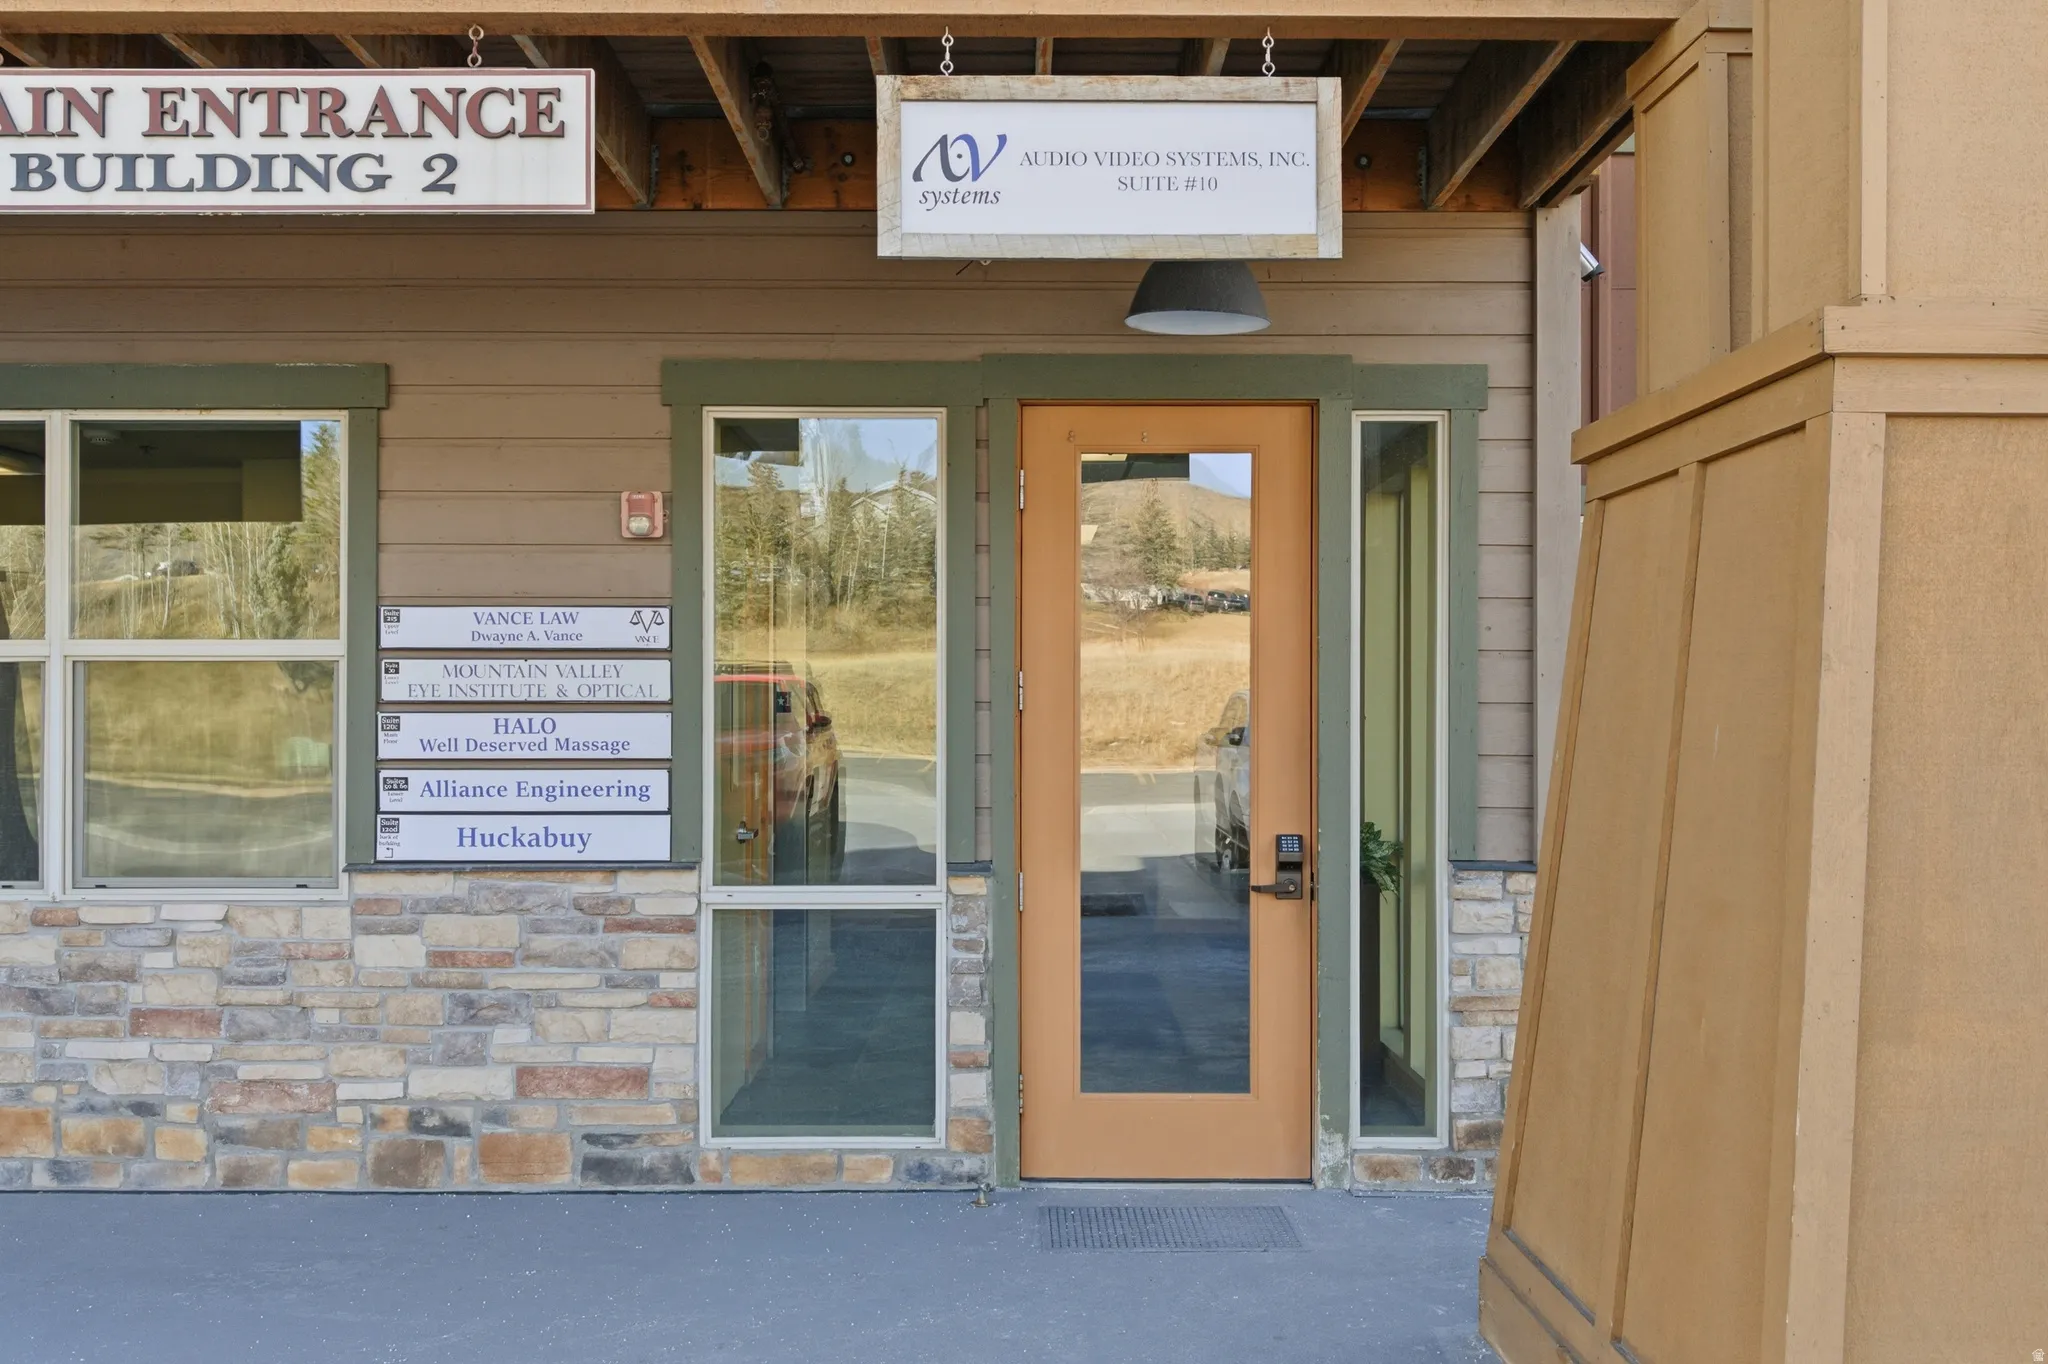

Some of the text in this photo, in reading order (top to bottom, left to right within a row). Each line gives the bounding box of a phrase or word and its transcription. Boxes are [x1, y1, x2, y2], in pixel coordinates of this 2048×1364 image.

[142, 86, 566, 139] ENTRANCE
[1020, 151, 1310, 169] AUDIO VIDEO SYSTEMS, INC.
[10, 153, 458, 193] BUILDING 2
[1117, 176, 1218, 192] SUITE #10
[919, 188, 1001, 211] systems
[473, 611, 580, 625] VANCE LAW
[471, 630, 584, 645] Dwayne A. Vance
[442, 664, 624, 679] MOUNTAIN VALLEY
[408, 683, 659, 699] EYE INSTITUTE & OPTICAL
[493, 717, 557, 735] HALO
[419, 737, 631, 756] Well Deserved Massage
[420, 780, 652, 802] Alliance Engineering
[457, 826, 592, 853] Huckabuy
